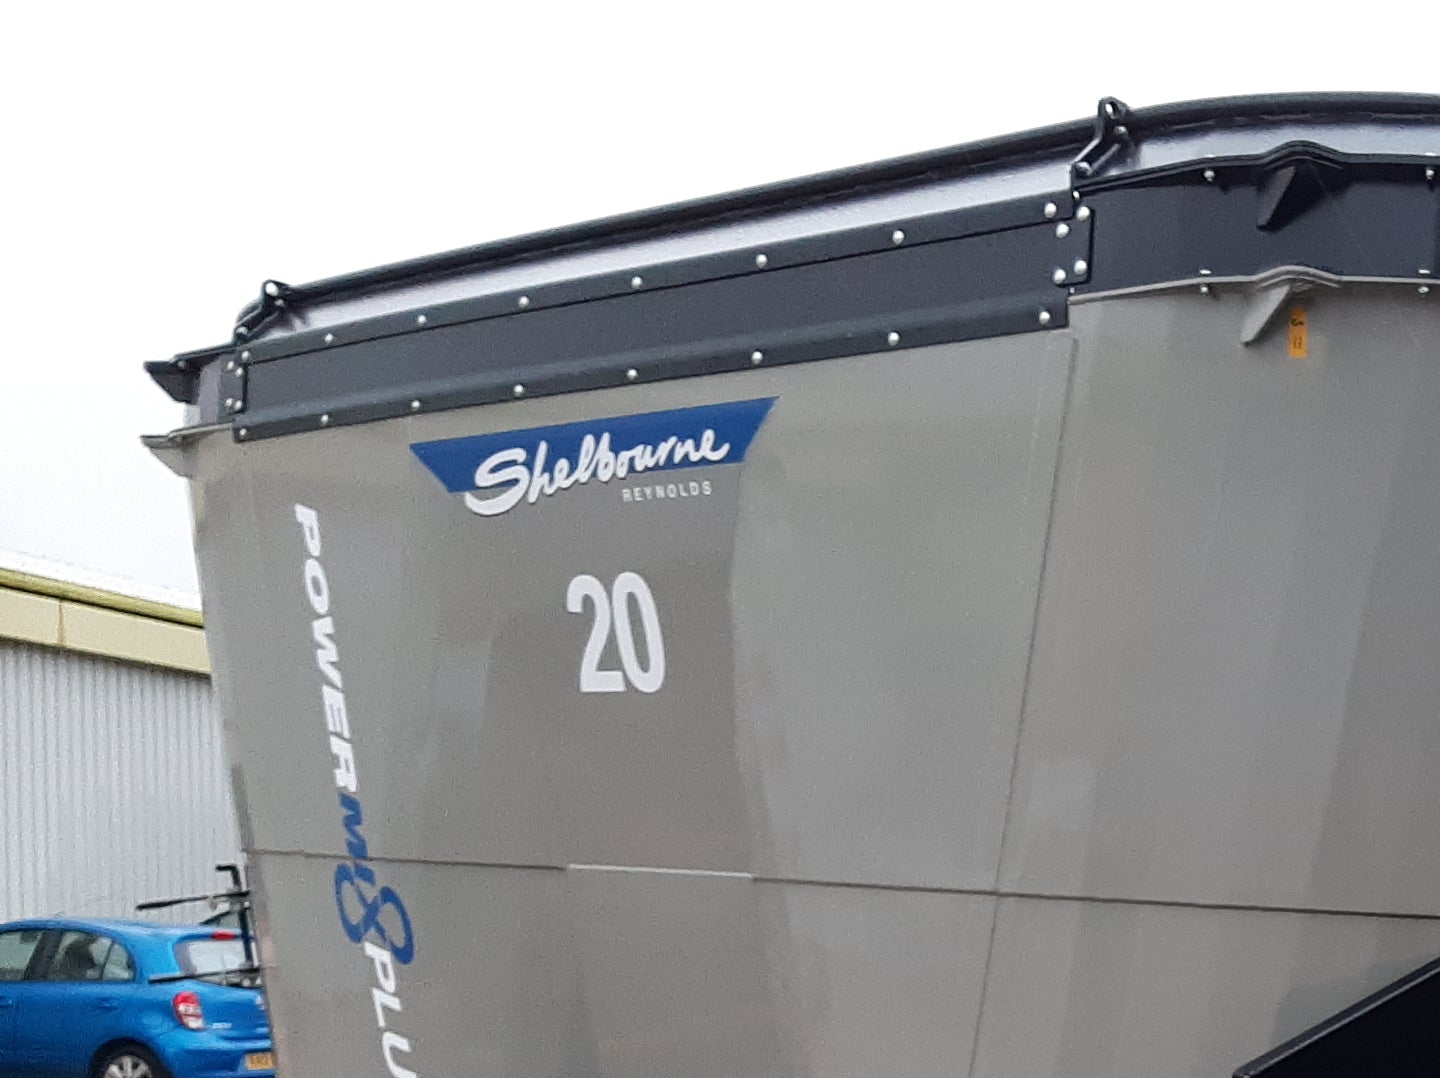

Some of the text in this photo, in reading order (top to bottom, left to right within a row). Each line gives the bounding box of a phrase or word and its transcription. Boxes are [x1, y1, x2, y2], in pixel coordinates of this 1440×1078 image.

[464, 429, 731, 516] Shelbourne
[621, 480, 713, 502] REYNOLDS
[566, 572, 666, 694] 20
